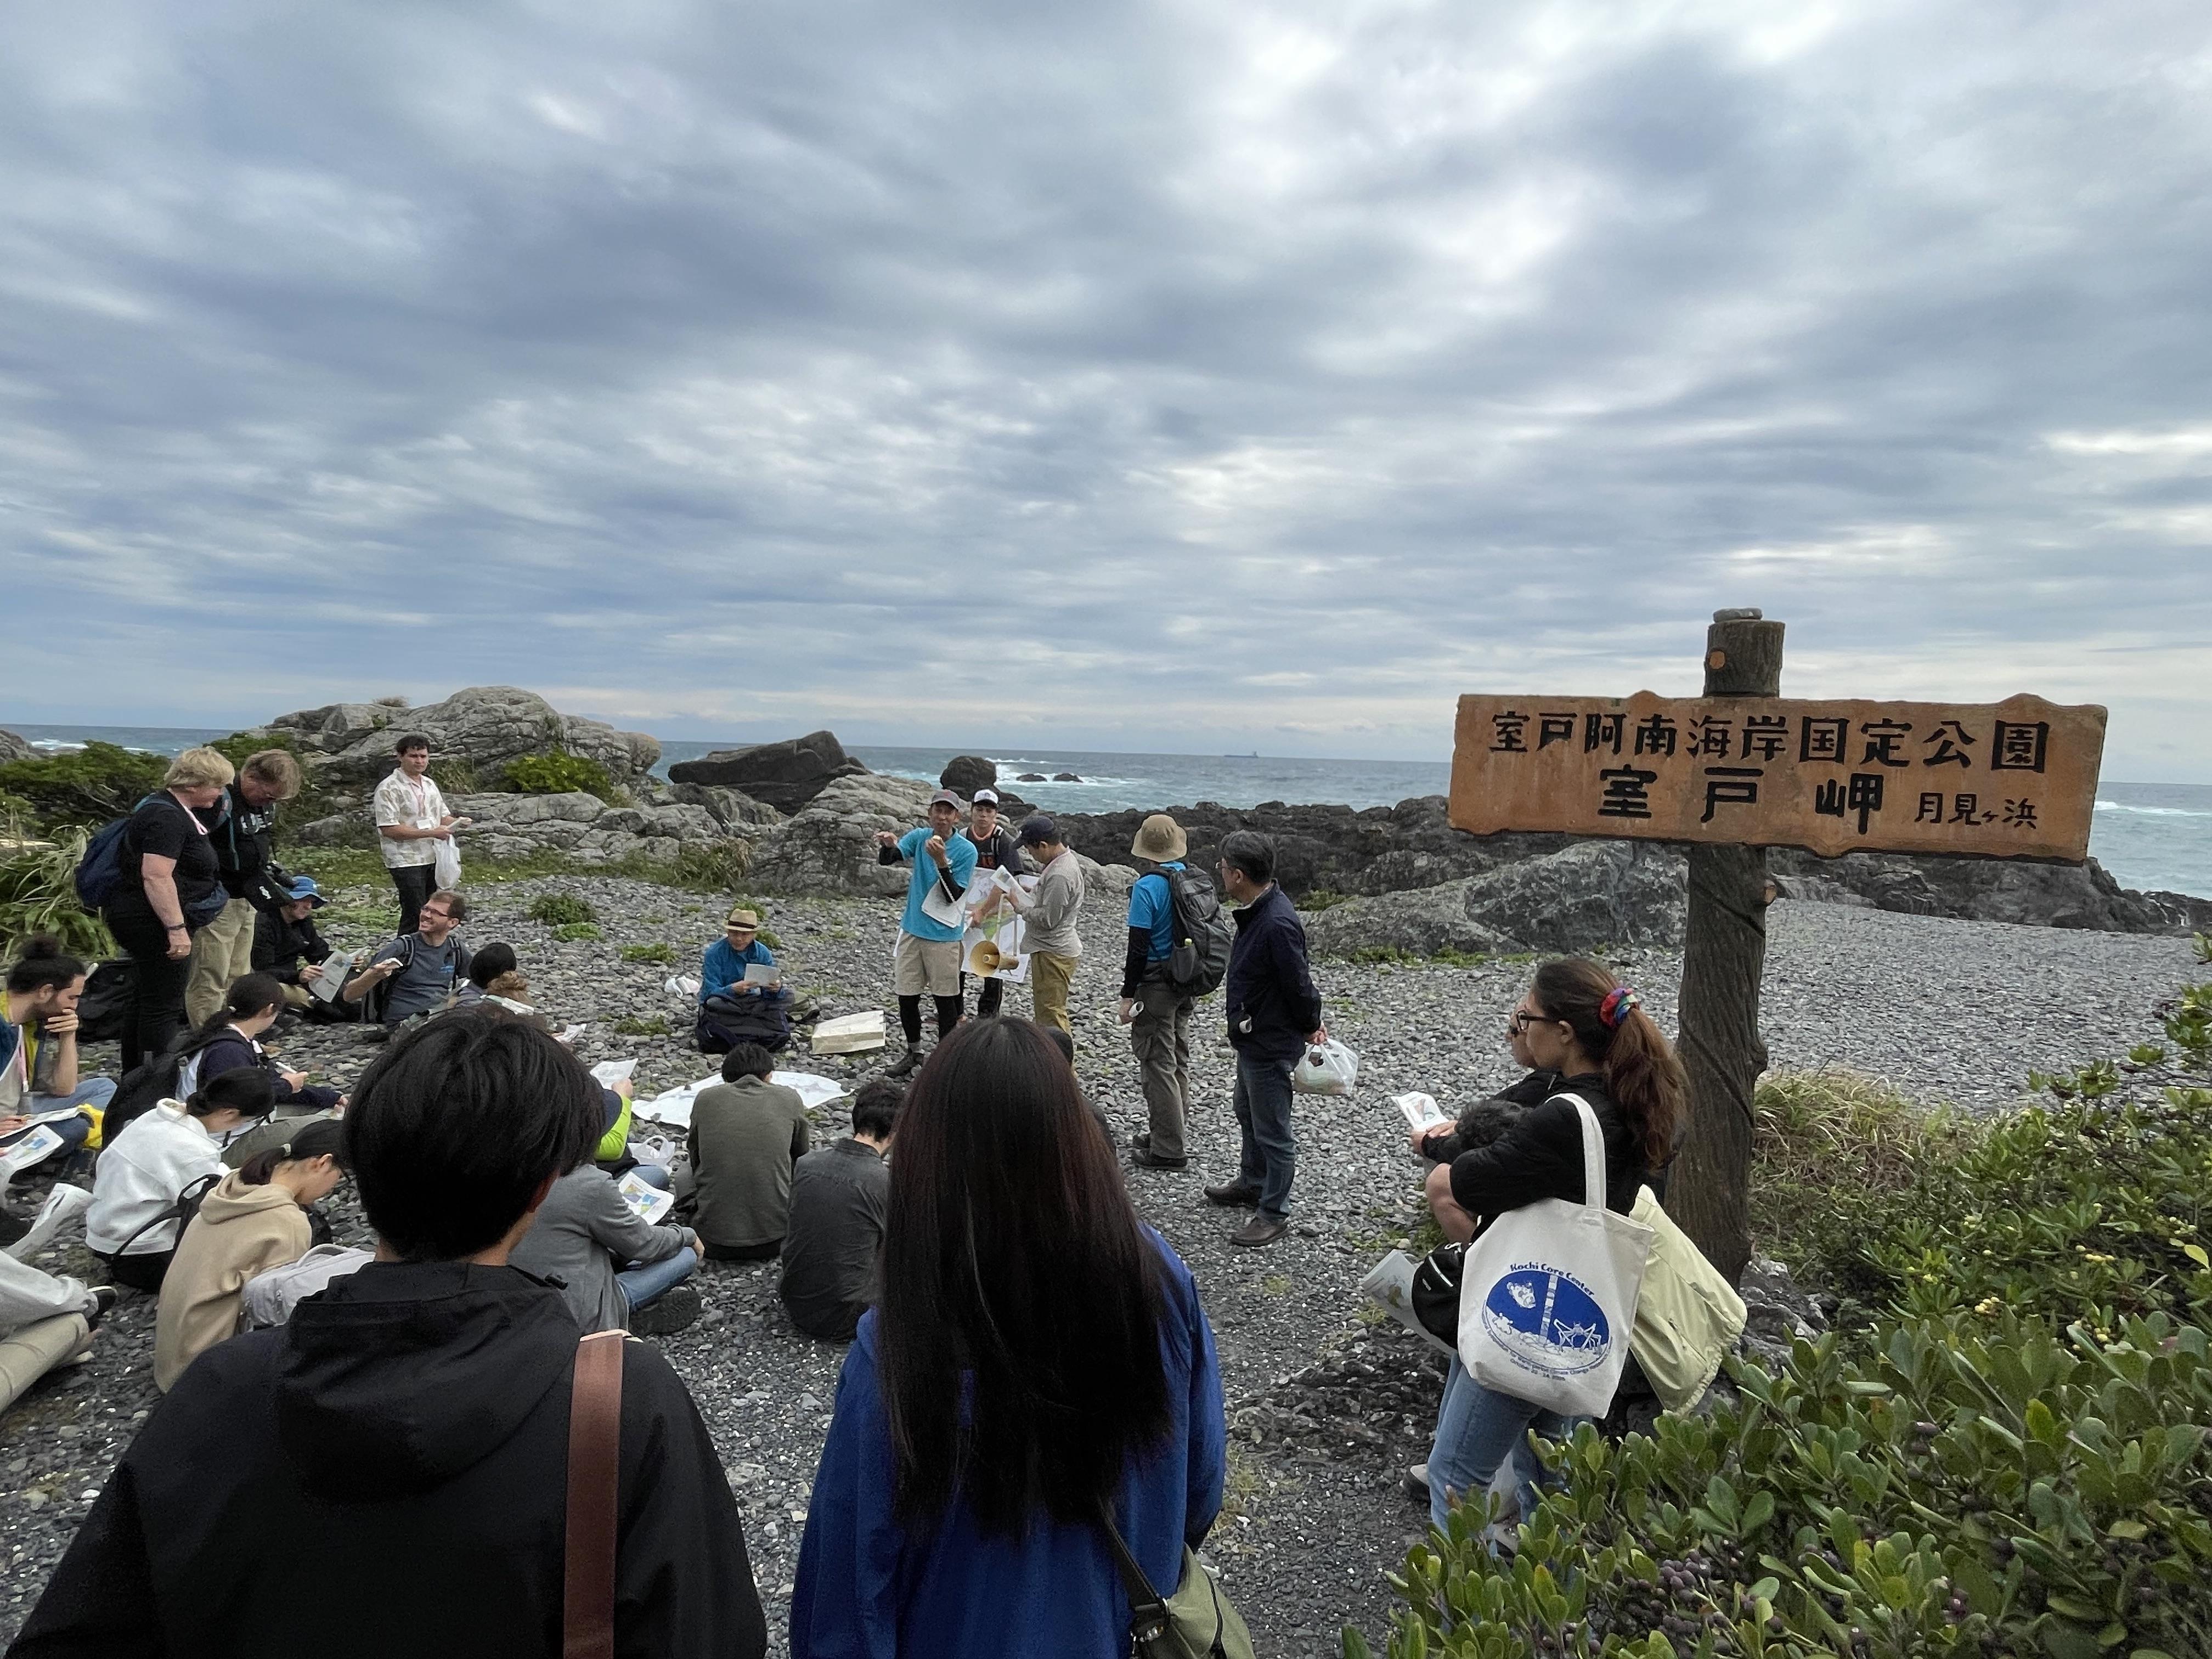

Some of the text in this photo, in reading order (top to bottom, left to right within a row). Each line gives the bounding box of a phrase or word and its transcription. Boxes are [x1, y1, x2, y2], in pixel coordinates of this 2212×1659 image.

[1488, 710, 2049, 774] 室戸阿南海岸国定公園
[1510, 1261, 1595, 1296] Kochi Core Center
